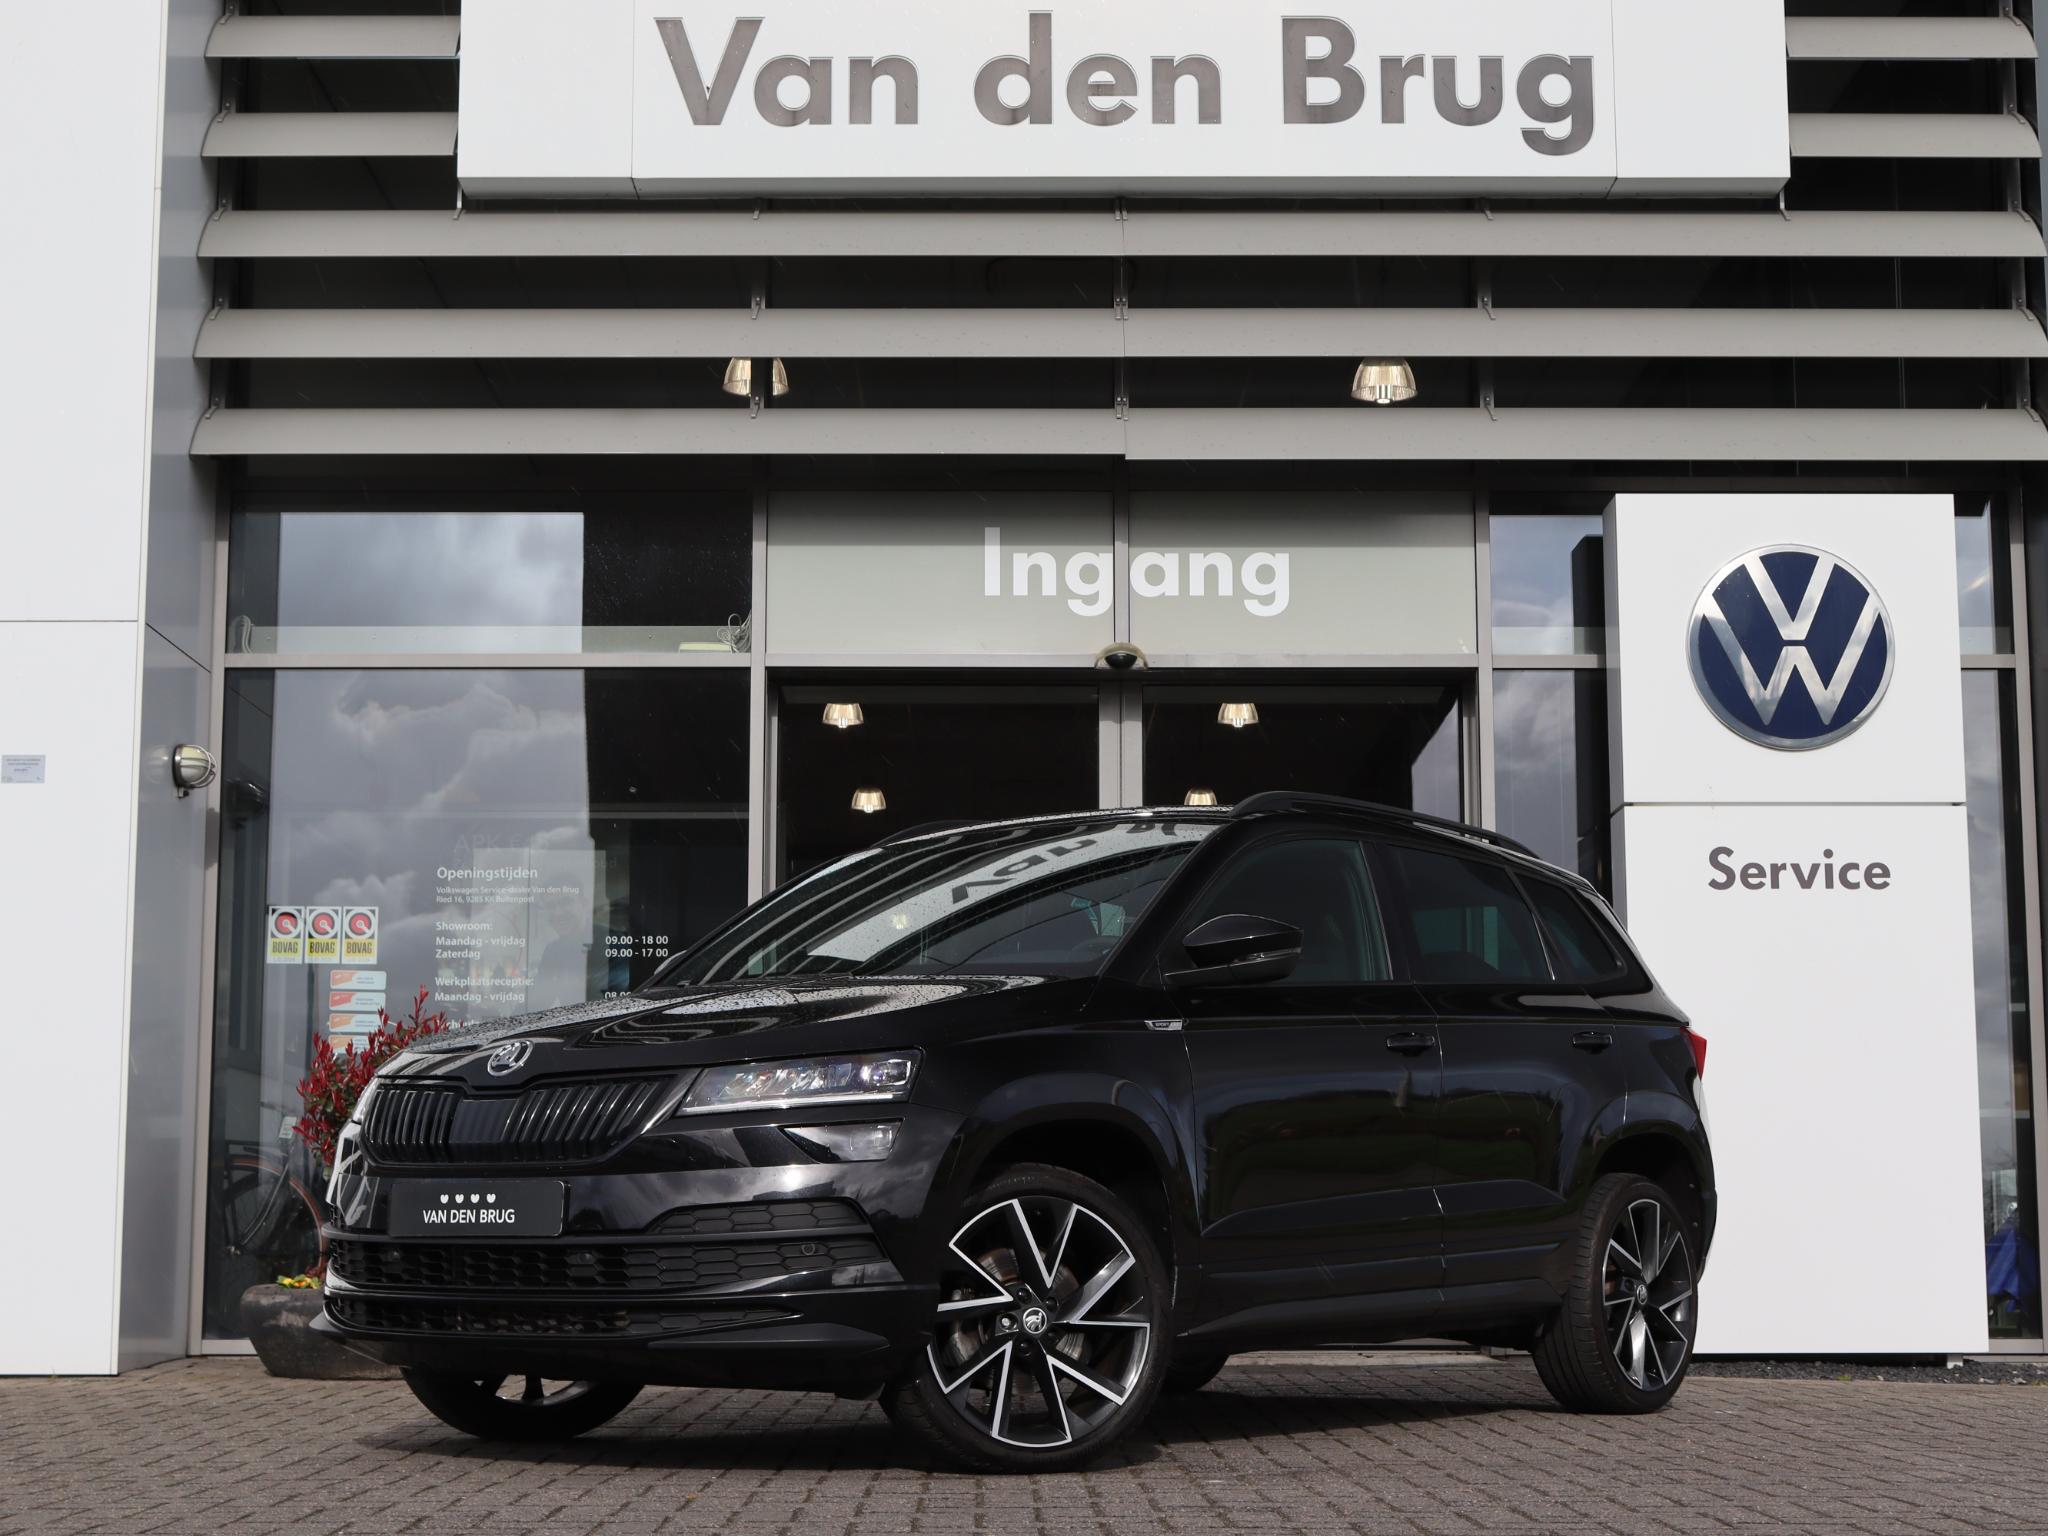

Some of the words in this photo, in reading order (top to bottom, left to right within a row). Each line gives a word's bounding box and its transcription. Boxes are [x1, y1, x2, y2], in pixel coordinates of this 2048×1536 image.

[653, 15, 920, 127] Van
[973, 10, 1222, 127] den
[1281, 15, 1594, 157] Brug
[984, 526, 1290, 617] Ingang
[436, 866, 538, 882] Openingstijden
[1708, 846, 1891, 891] Service
[272, 941, 299, 954] BOVAG
[309, 941, 336, 954] BOVAG
[346, 941, 373, 954] BOVAG
[435, 936, 483, 948] Maandag
[491, 936, 526, 948] vrijdag
[605, 935, 633, 945] 09.00
[435, 948, 481, 960] Zaterdag
[605, 948, 633, 958] 09.00
[434, 991, 482, 1003] Maandag
[490, 991, 526, 1003] vrijdag
[423, 1209, 447, 1224] VAN
[450, 1209, 476, 1224] DEN
[479, 1208, 516, 1224] BRUG
